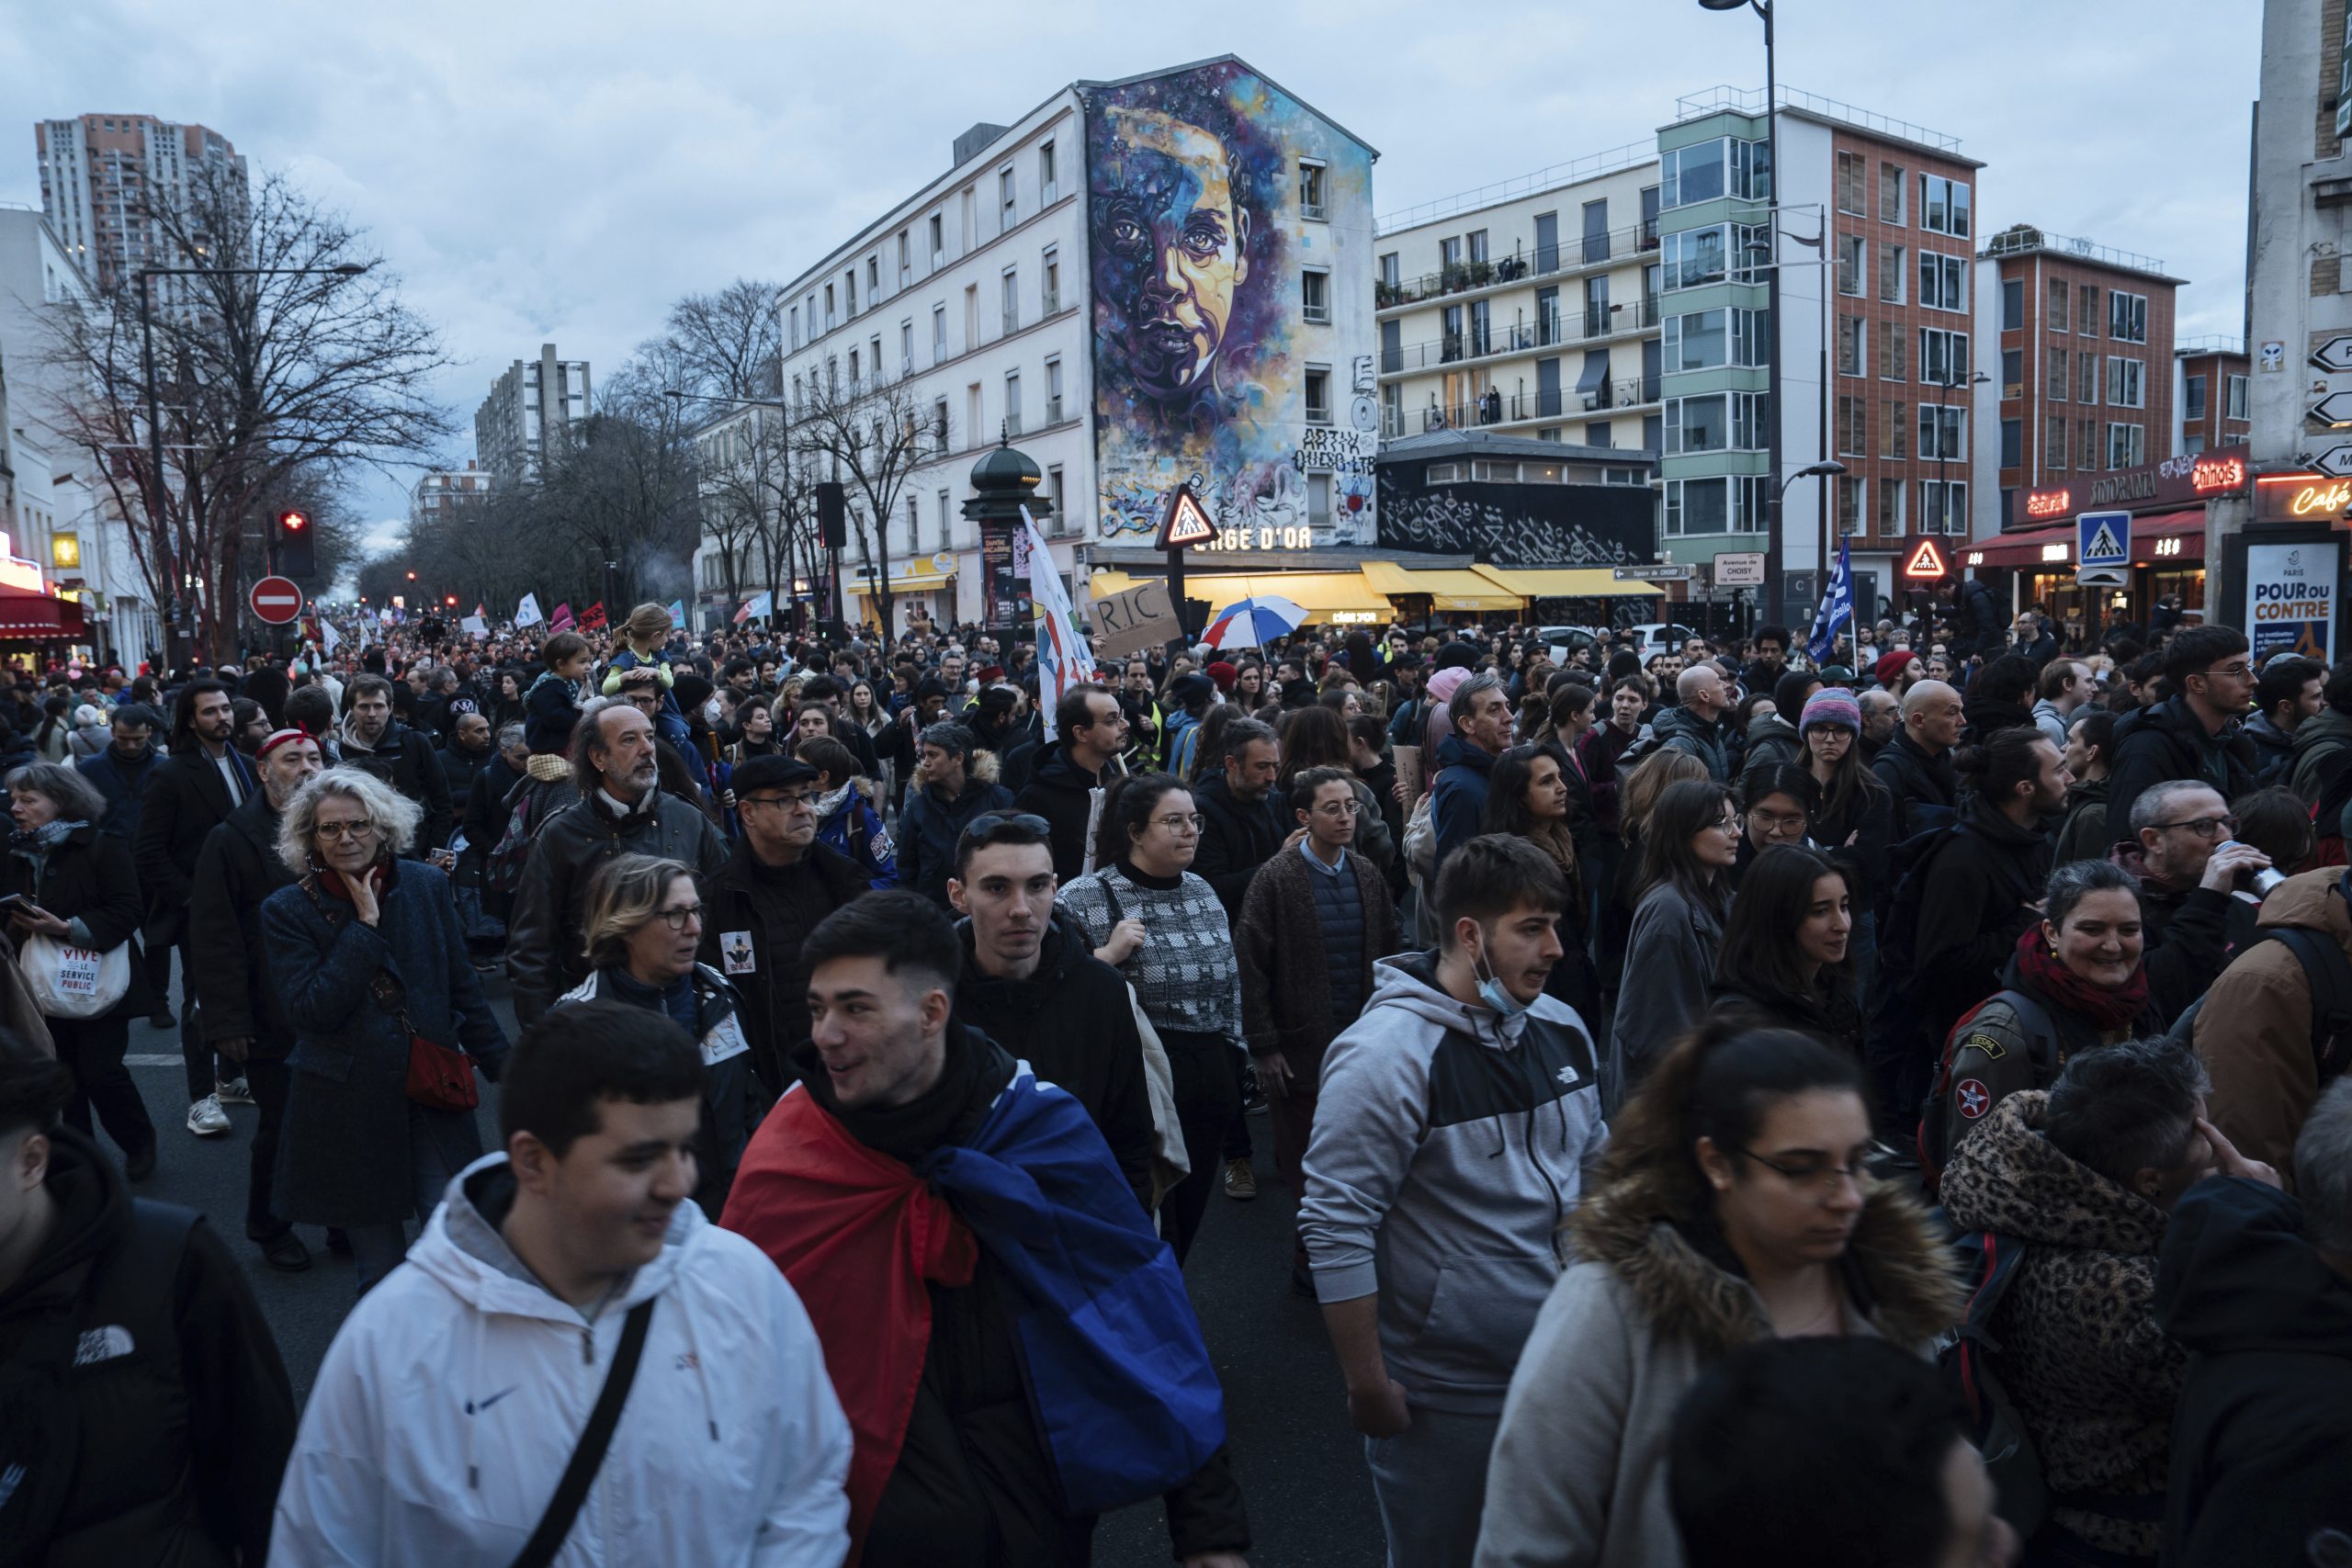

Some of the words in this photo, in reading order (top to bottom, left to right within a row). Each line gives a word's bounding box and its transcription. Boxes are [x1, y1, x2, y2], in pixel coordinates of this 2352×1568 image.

[2191, 459, 2236, 486] Chinois
[2292, 481, 2351, 514] Café
[1727, 567, 1752, 575] CHOISY
[2256, 582, 2307, 601] POUR
[2309, 586, 2329, 598] OU
[2256, 601, 2329, 620] CONTRE
[63, 949, 98, 962] VIVE
[61, 970, 96, 981] SERVICE
[62, 979, 92, 990] PUBLIC
